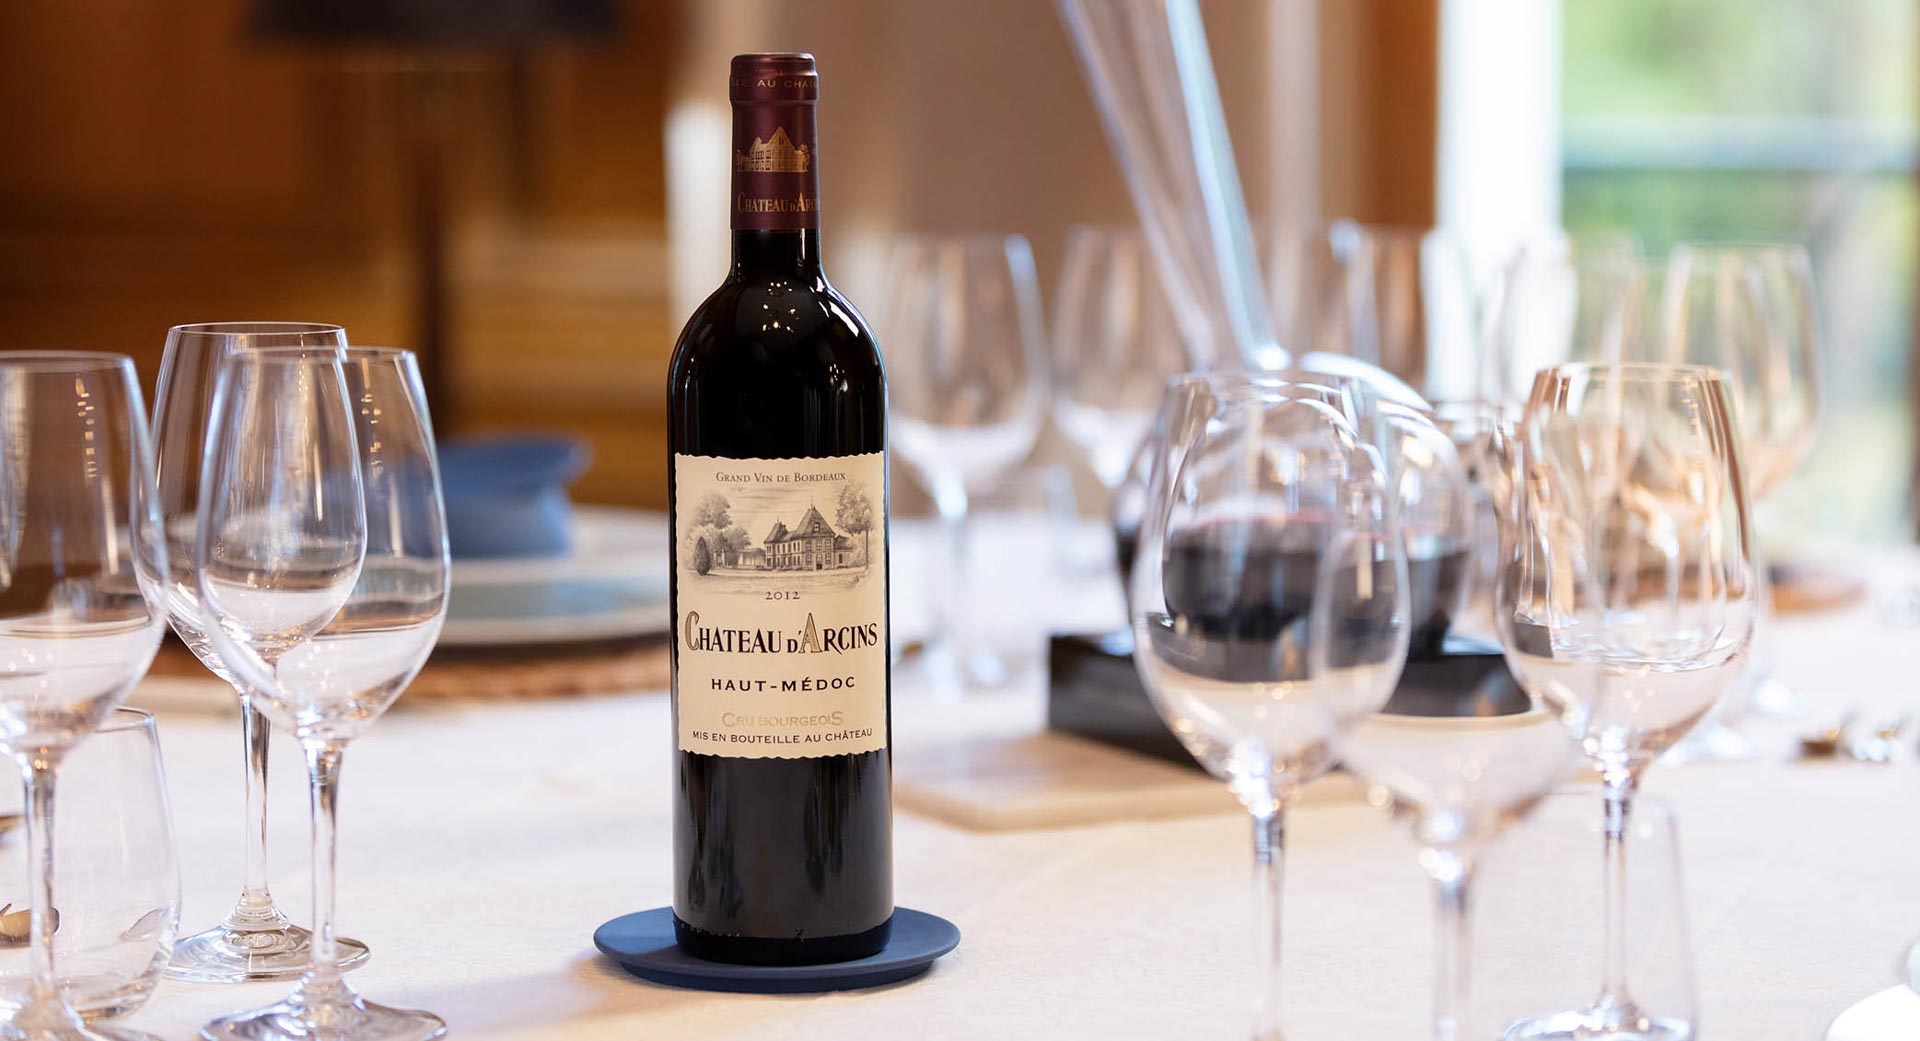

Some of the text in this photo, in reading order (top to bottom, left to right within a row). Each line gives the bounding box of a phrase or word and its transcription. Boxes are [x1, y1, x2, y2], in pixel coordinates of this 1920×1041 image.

[757, 79, 776, 88] AU
[737, 191, 789, 213] CHATEAU
[716, 471, 846, 483] GRAND VIN DE BORDEAUX
[765, 591, 800, 601] 2012
[685, 611, 878, 655] CHATEAU D'ARCINS
[711, 676, 855, 692] HAUT-MÉDOC
[722, 711, 844, 728] CRU BOURGEOIS
[692, 728, 873, 744] MIS EN BOUTEILLE AU CHÂTEAU
